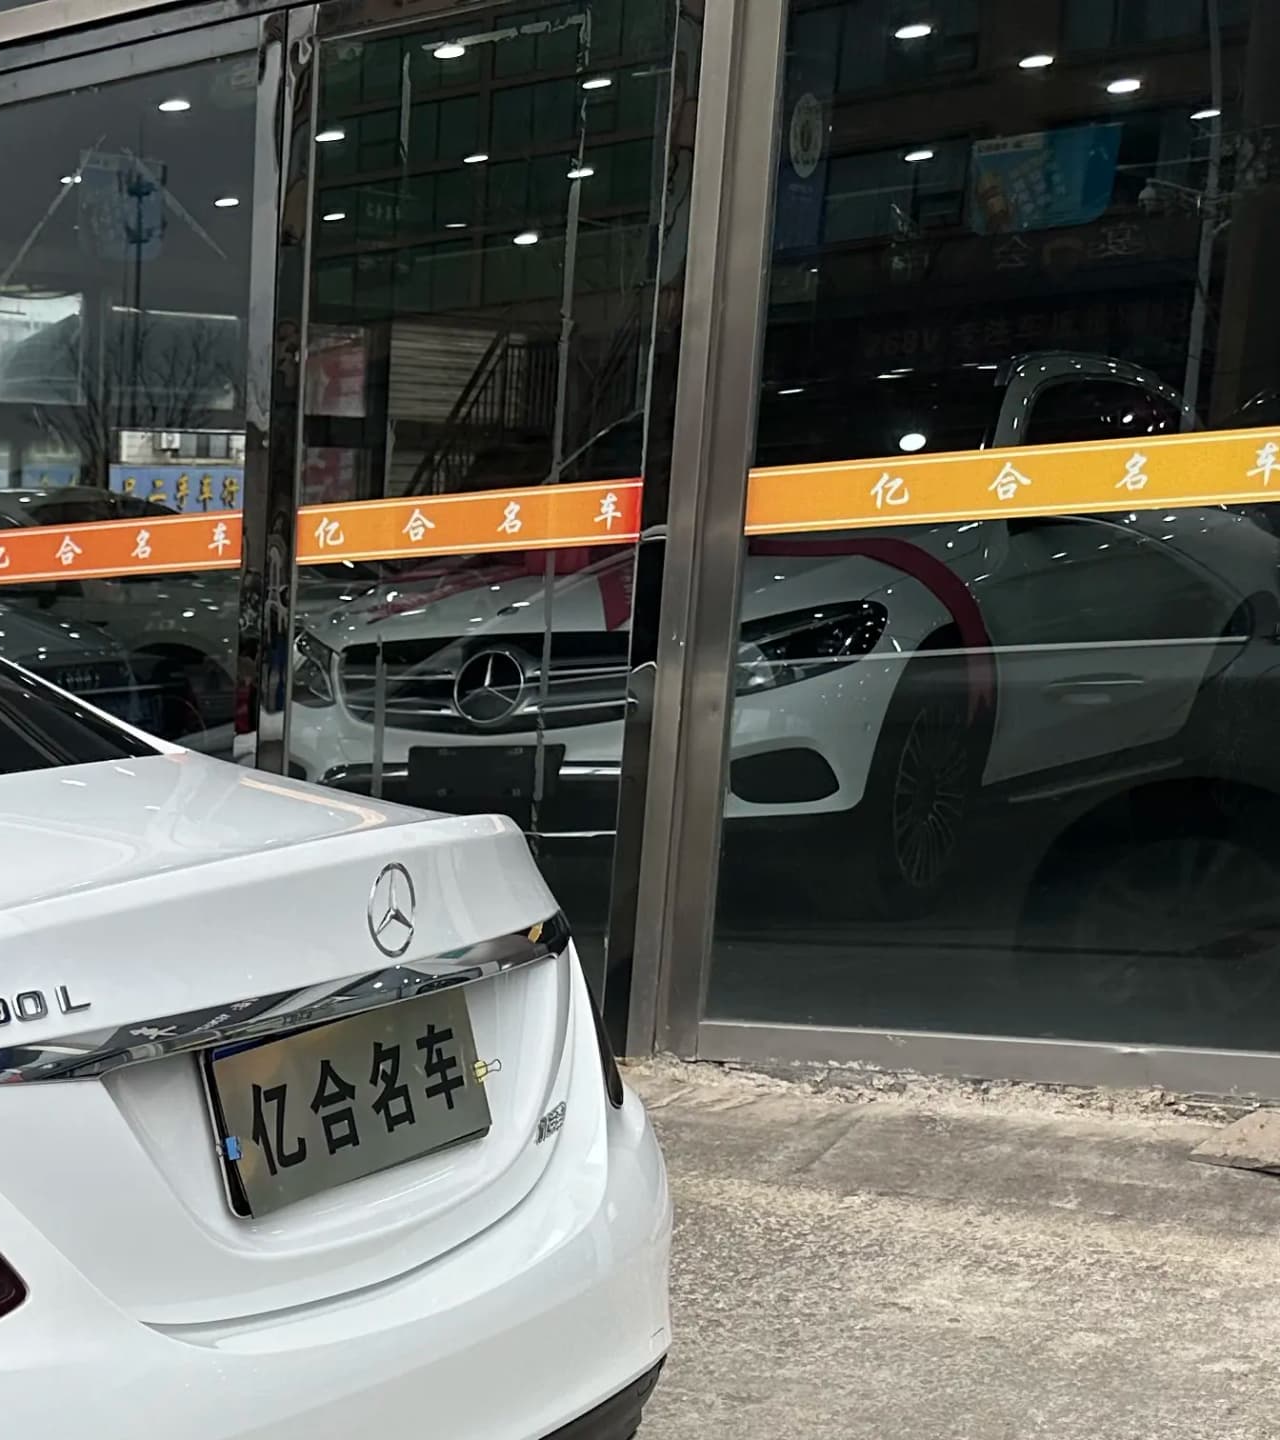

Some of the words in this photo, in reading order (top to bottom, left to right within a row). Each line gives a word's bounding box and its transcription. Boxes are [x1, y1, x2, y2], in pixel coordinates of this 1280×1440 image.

[870, 441, 1280, 510] 亿合名车
[314, 493, 623, 547] 亿合名车
[251, 1023, 466, 1177] 亿合名车
